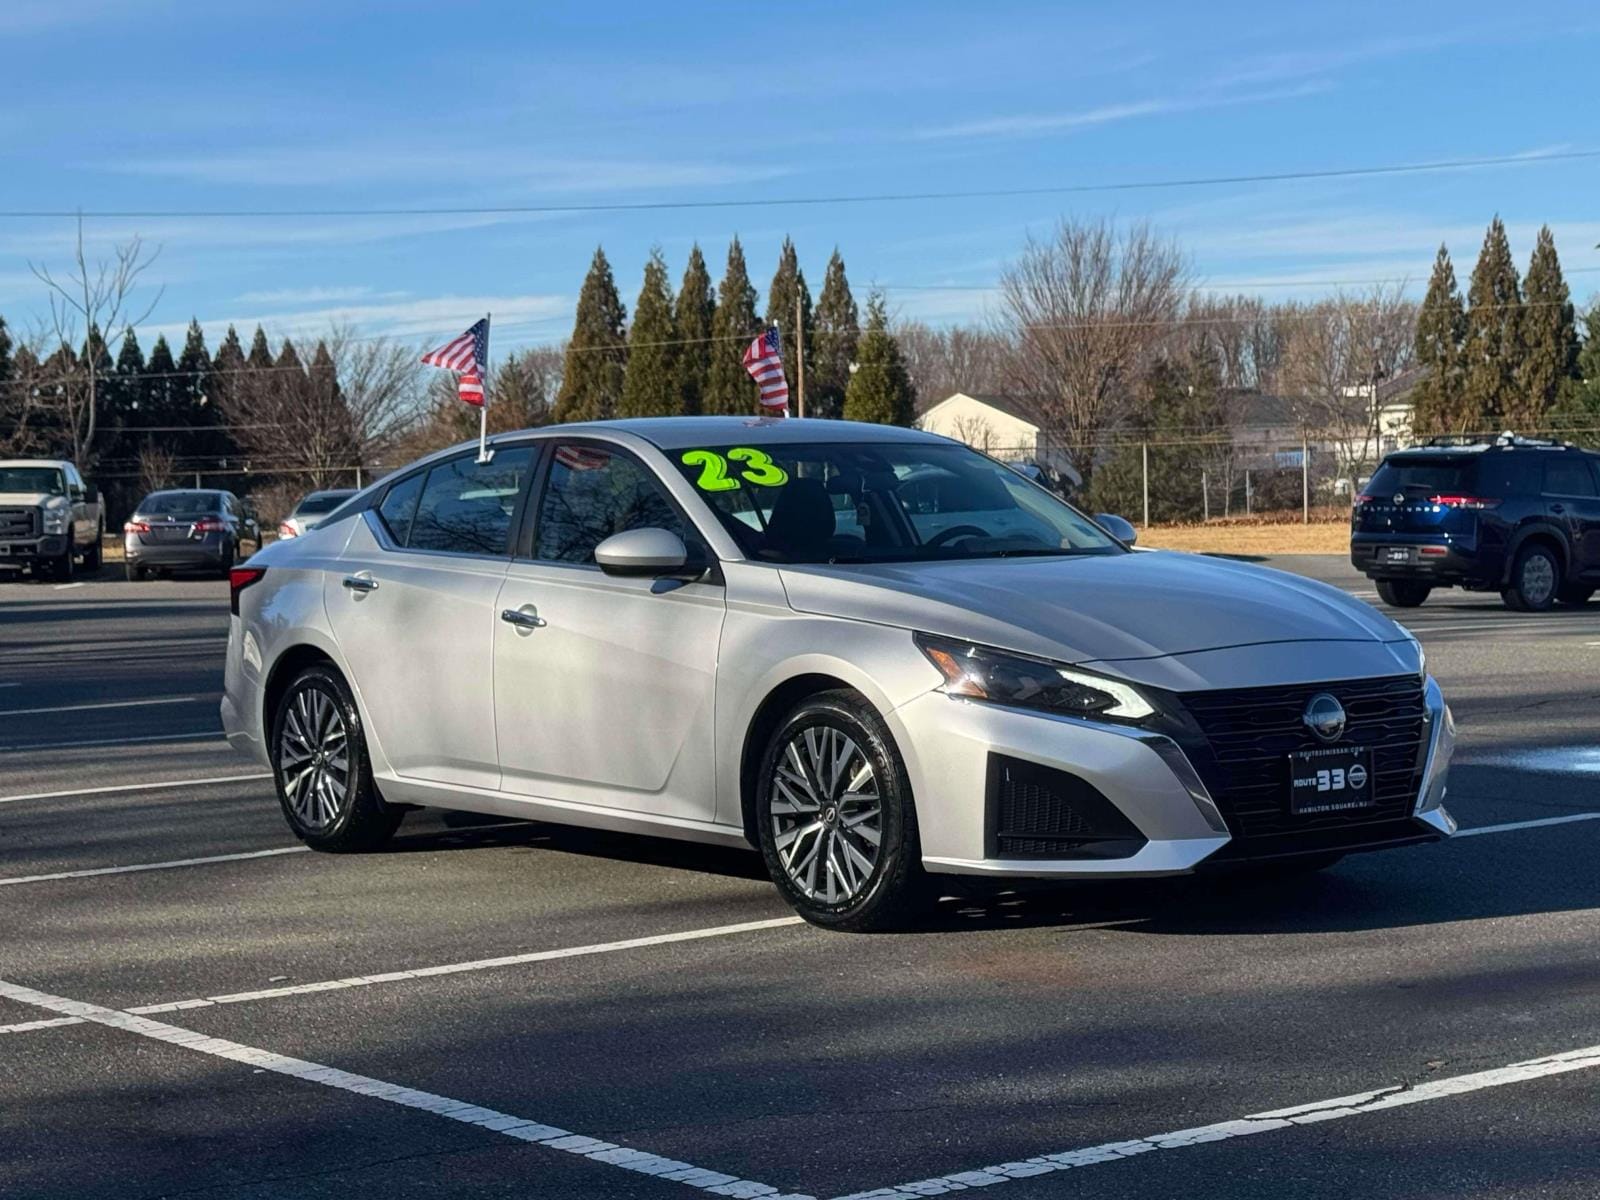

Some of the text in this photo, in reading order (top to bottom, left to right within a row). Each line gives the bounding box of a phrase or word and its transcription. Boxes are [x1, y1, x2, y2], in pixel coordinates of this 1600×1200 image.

[682, 448, 789, 492] 23
[1293, 777, 1317, 788] ROUTE
[1316, 768, 1346, 792] 33
[1299, 805, 1330, 814] HAMILTON
